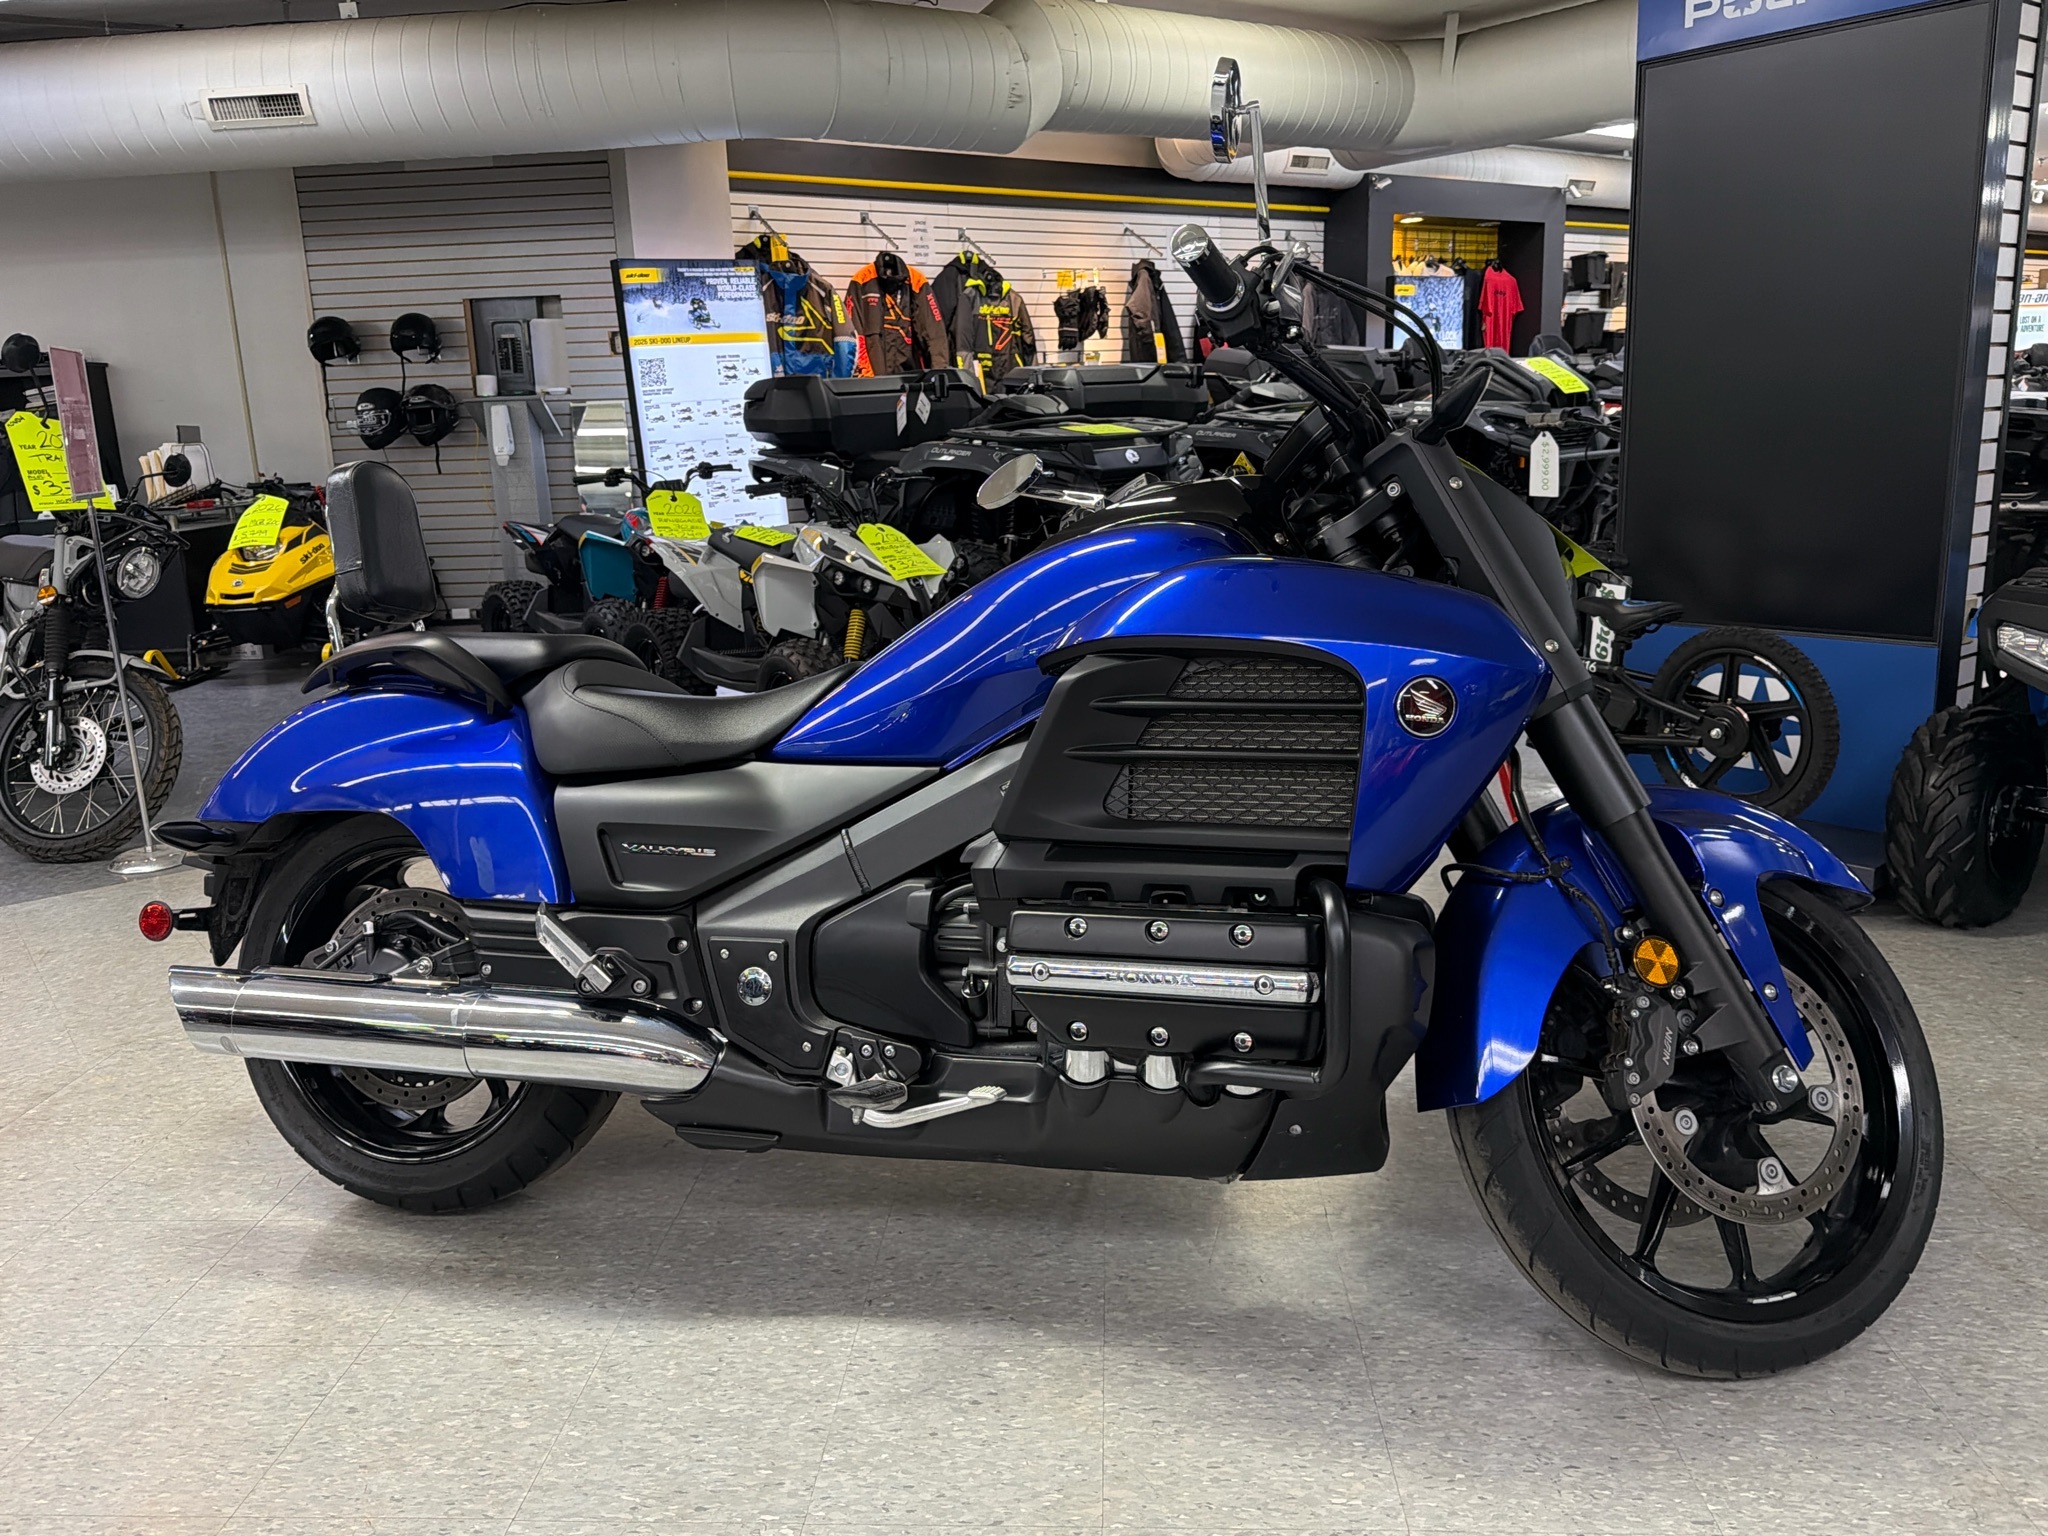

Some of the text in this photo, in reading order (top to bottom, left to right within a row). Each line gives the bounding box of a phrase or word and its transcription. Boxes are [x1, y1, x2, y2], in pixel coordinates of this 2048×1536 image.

[833, 294, 845, 324] ROTAX
[926, 293, 942, 322] ROTAX
[1195, 430, 1237, 438] OUTLANDER
[931, 447, 971, 457] OUTLANDER
[300, 543, 325, 564] ski-doo
[1405, 713, 1446, 724] HONDA
[621, 842, 717, 857] VALKYRIE
[1105, 972, 1196, 987] HONDA
